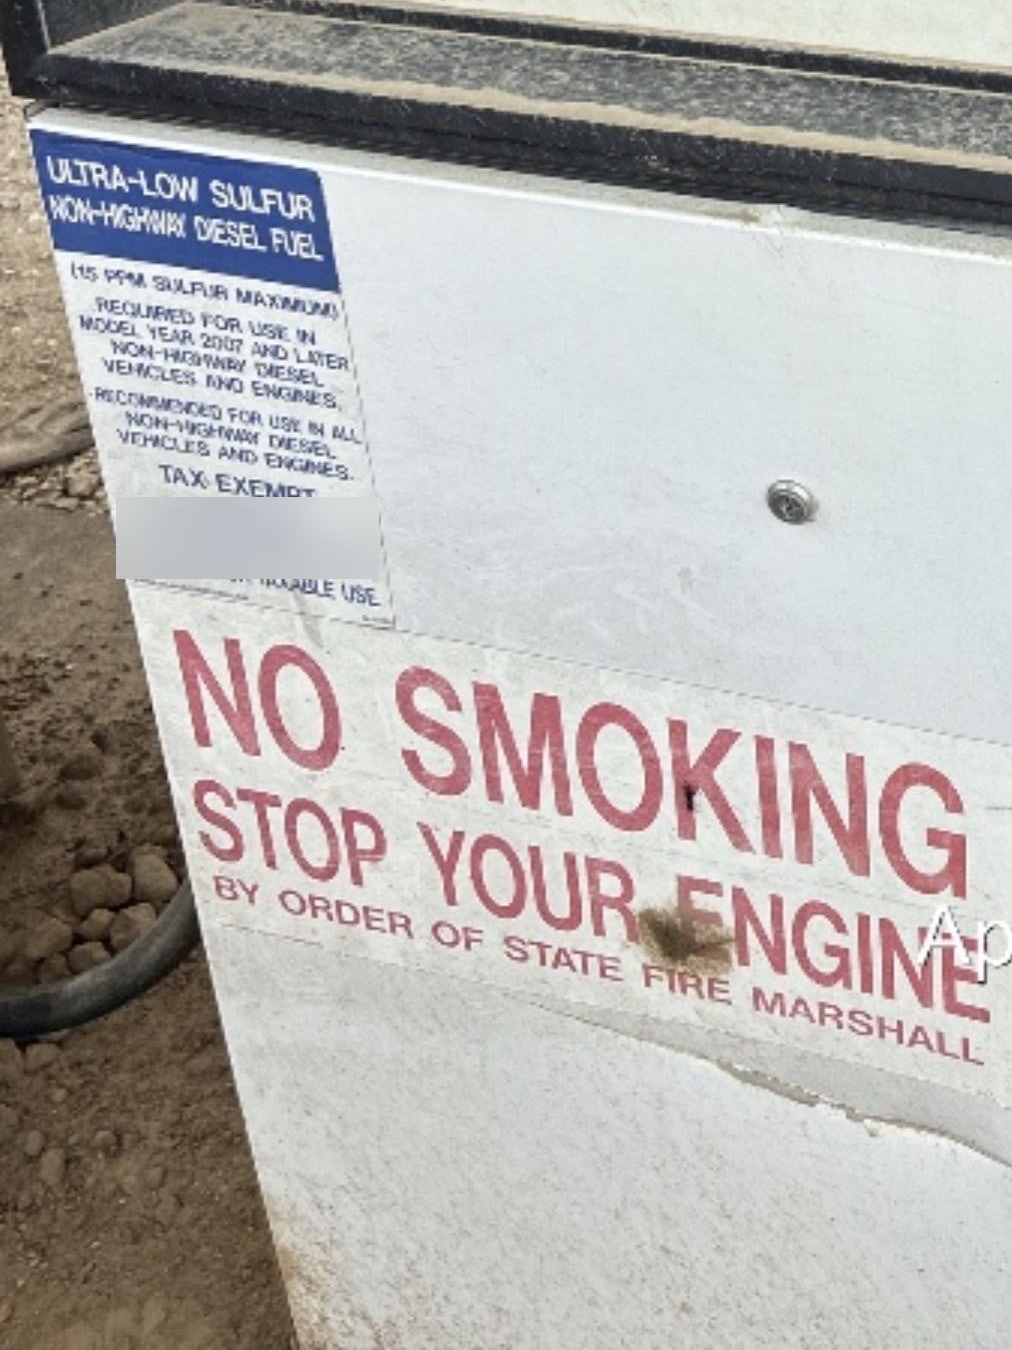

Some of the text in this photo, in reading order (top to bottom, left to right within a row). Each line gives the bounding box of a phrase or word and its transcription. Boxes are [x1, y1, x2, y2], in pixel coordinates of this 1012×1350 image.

[46, 155, 315, 223] ULTRA-LOW SULFUR
[48, 195, 324, 262] NON-HIGHWAY DIESEL FUEL
[104, 269, 147, 288] PPM
[152, 275, 228, 301] SULFUR
[79, 315, 349, 370] MODEL YEAR 2007 AND LATER
[96, 297, 316, 345] REQUIRED FOR USE IN
[101, 358, 197, 387] VEHICLES
[206, 375, 244, 393] AND
[110, 339, 324, 387] NON-HIGHWAY DIESEL
[94, 386, 362, 445] RECOMMENDED FOR USE IN ALL
[126, 410, 338, 460] NON-HIGHWAY DIESEL
[116, 428, 210, 457] VEHICLES
[218, 446, 258, 465] AND
[158, 464, 207, 490] TAX
[341, 581, 382, 607] USE
[173, 629, 967, 900] NO SMOKING
[192, 779, 991, 1024] STOP YOUR ENGINE
[212, 875, 984, 1066] BY ORDER OF STATE FIRE MARSHALL
